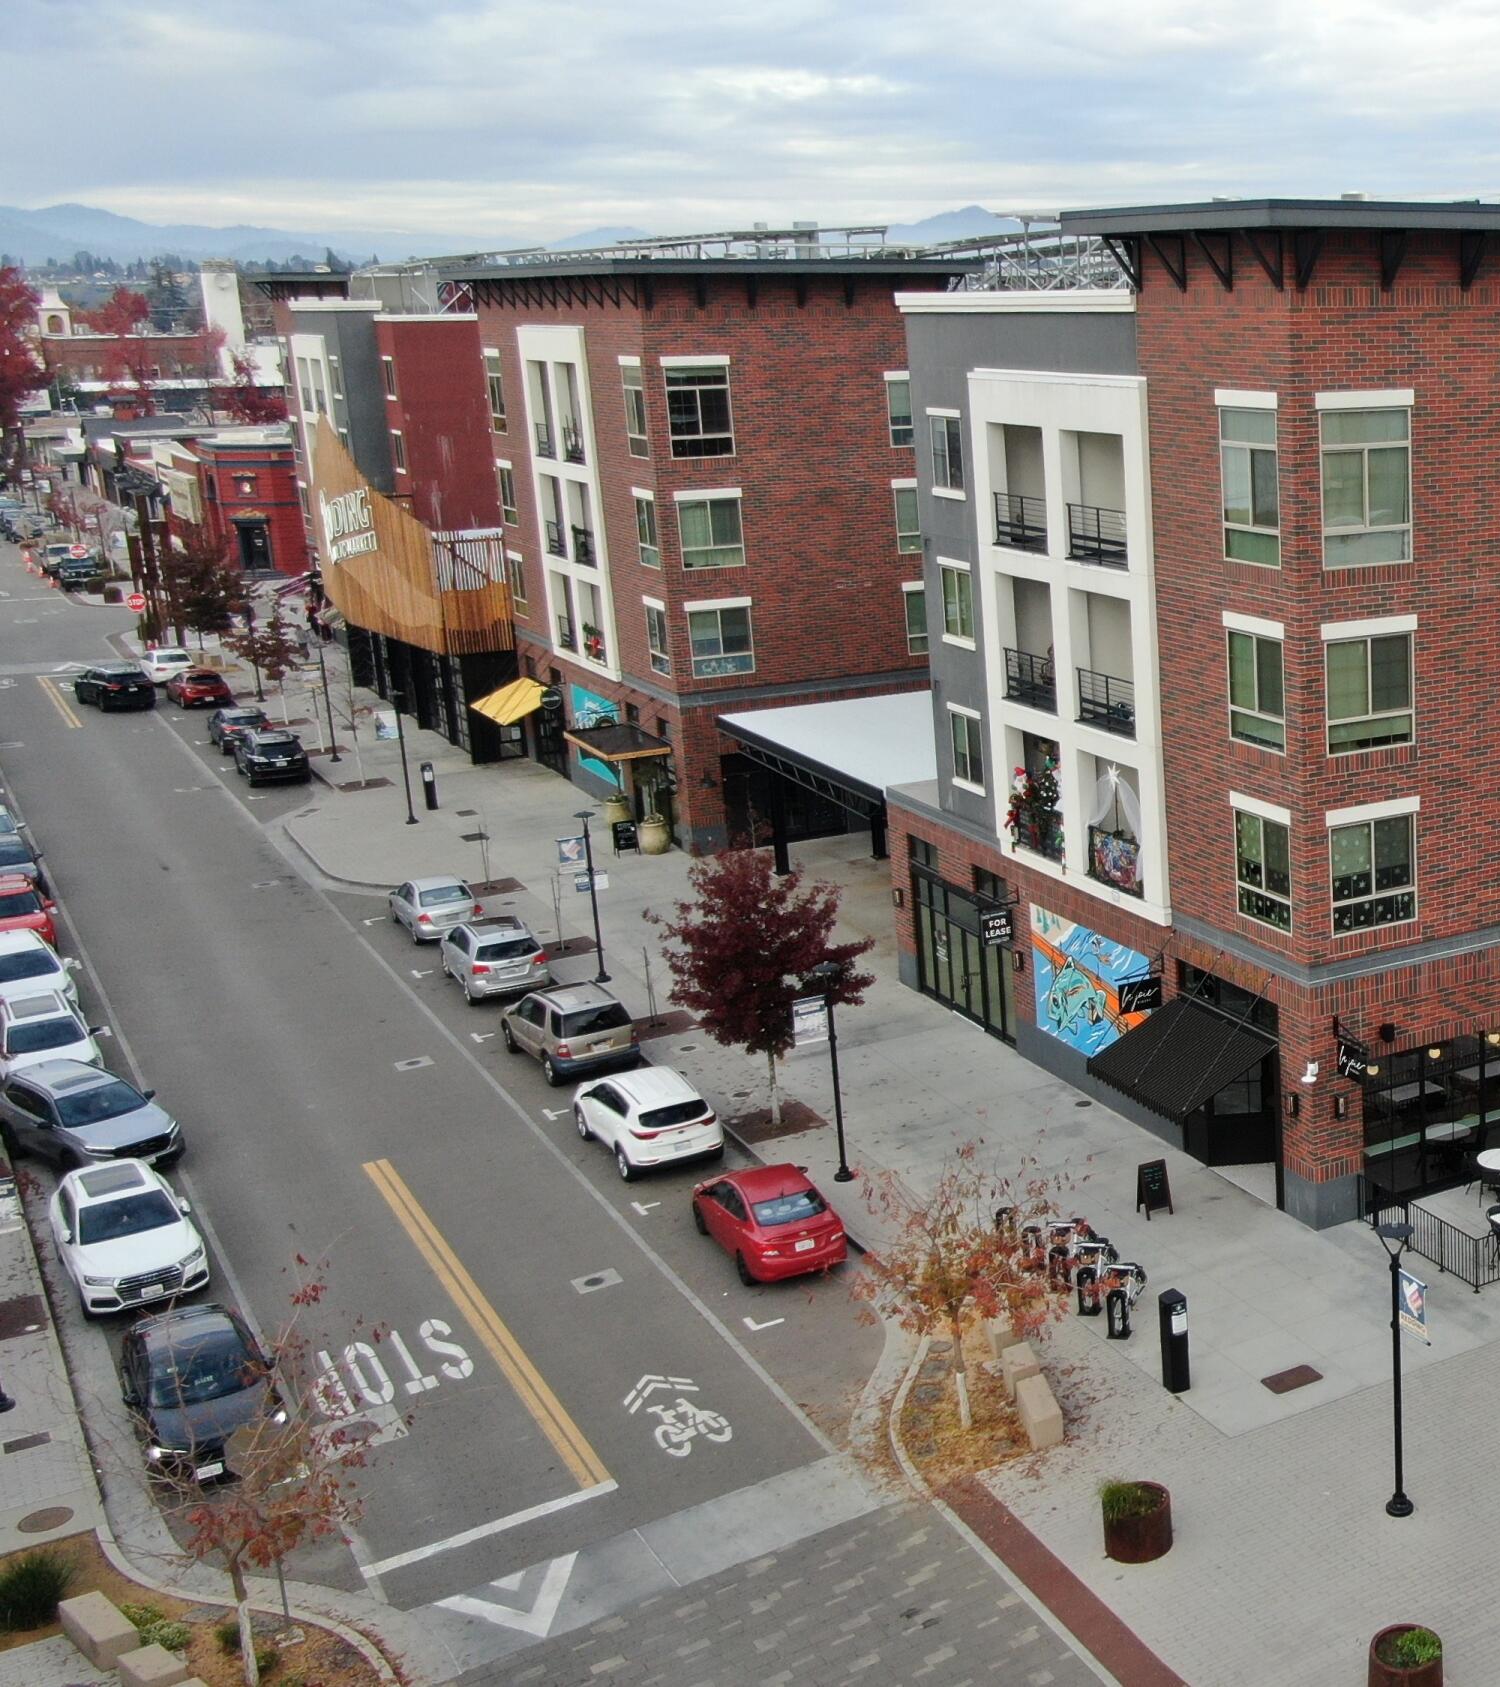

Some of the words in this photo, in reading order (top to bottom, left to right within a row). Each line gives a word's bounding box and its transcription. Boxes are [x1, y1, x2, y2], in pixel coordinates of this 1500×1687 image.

[127, 598, 145, 606] STOP
[989, 918, 1006, 928] FOR
[985, 926, 1012, 938] LEASE
[311, 1318, 475, 1418] STOP
